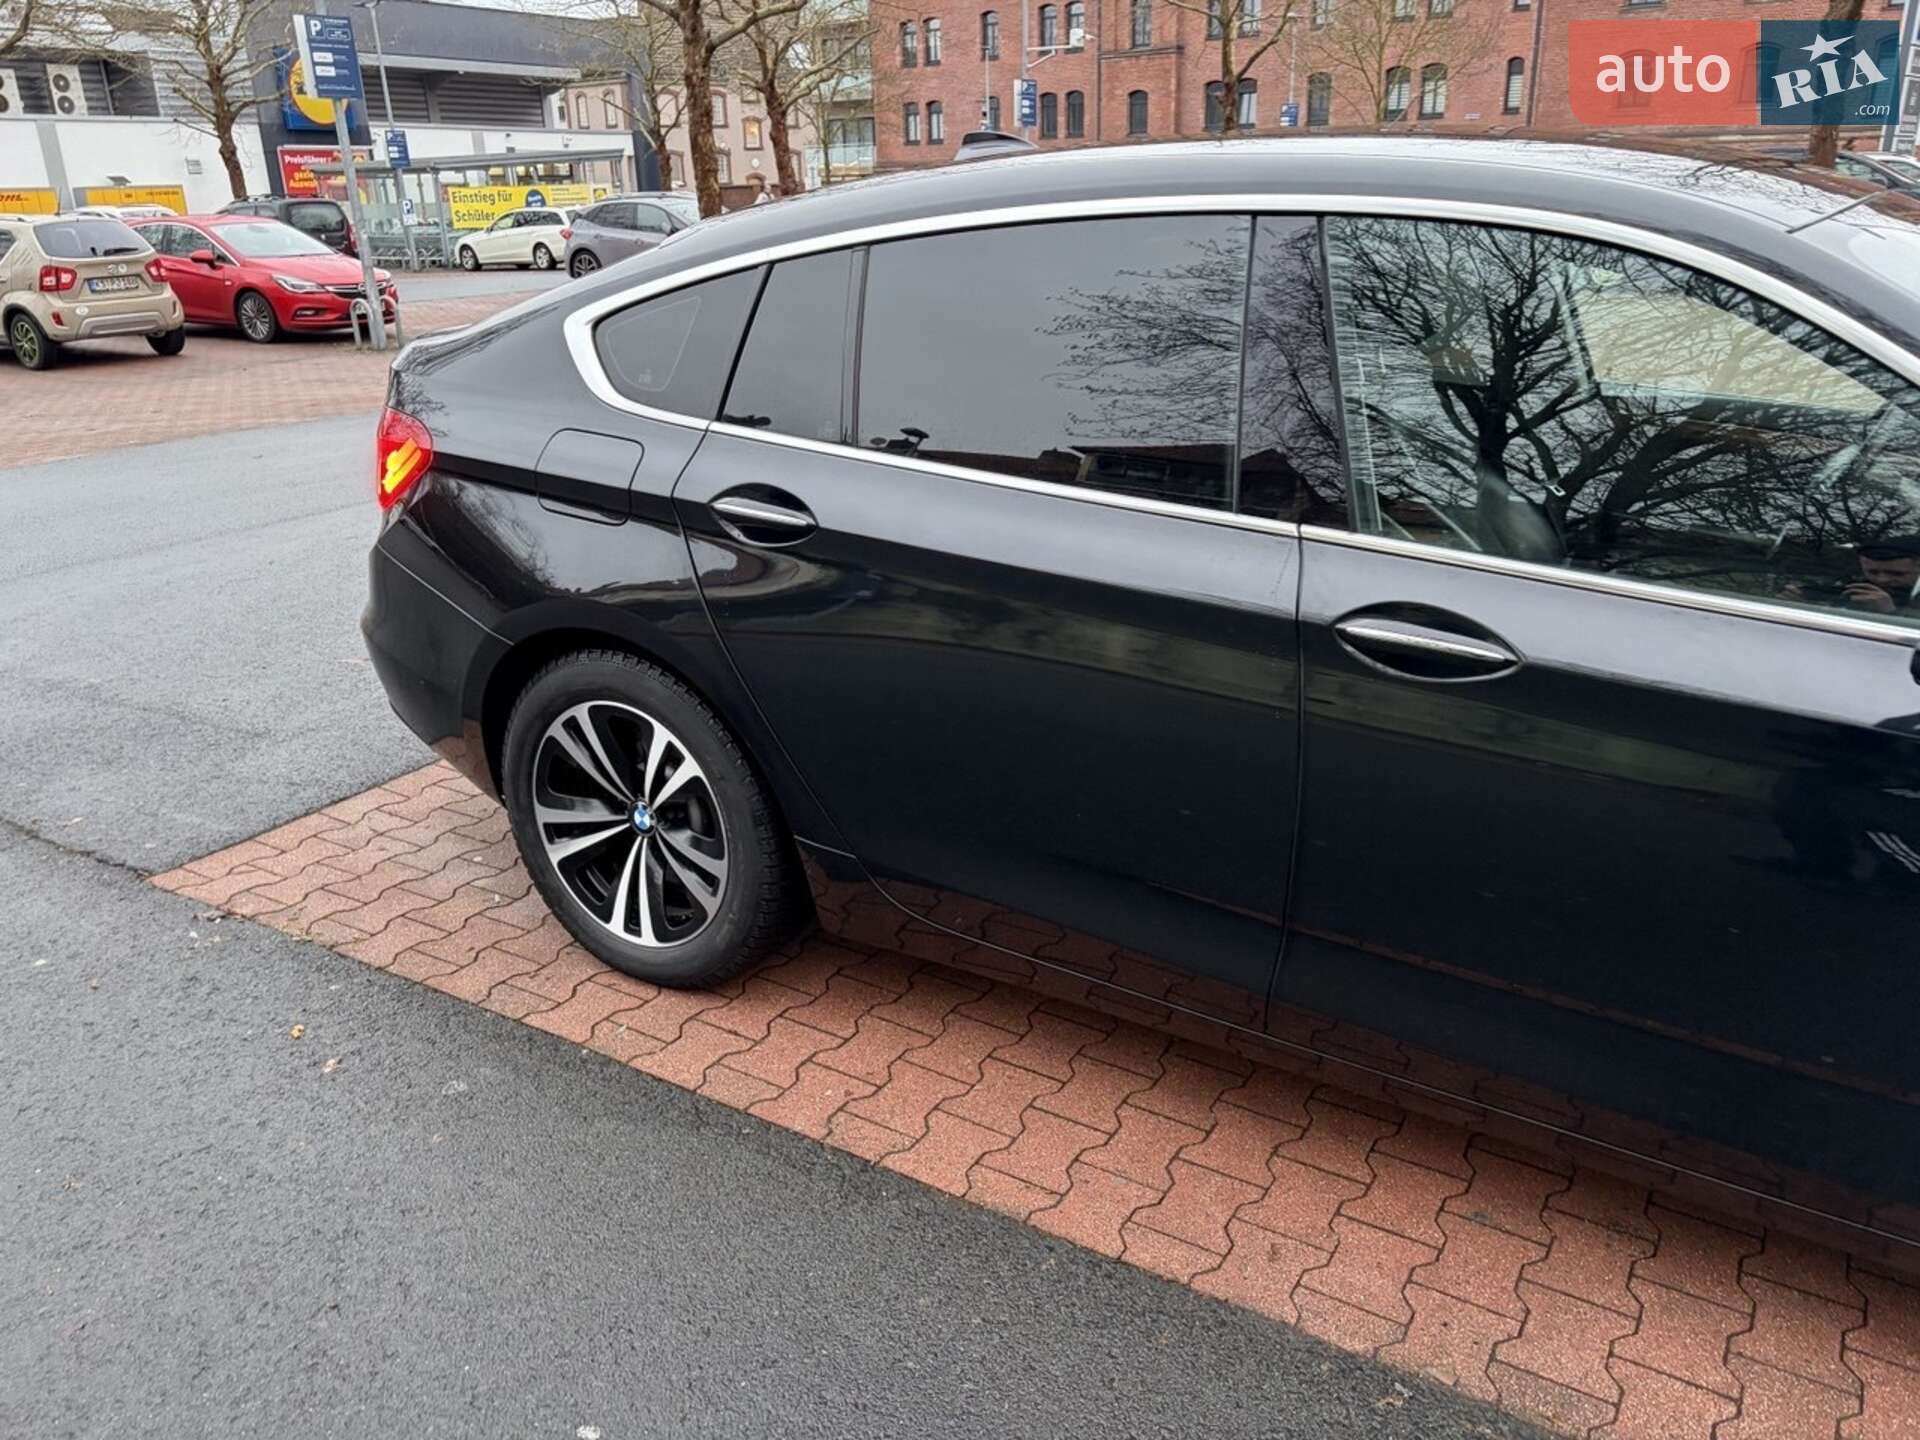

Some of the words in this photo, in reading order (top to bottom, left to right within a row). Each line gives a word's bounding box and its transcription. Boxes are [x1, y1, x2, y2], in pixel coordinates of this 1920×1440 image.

[309, 19, 322, 36] P
[452, 190, 496, 206] Einstieg
[498, 191, 512, 203] für
[402, 200, 412, 216] P
[454, 211, 495, 223] Schüler
